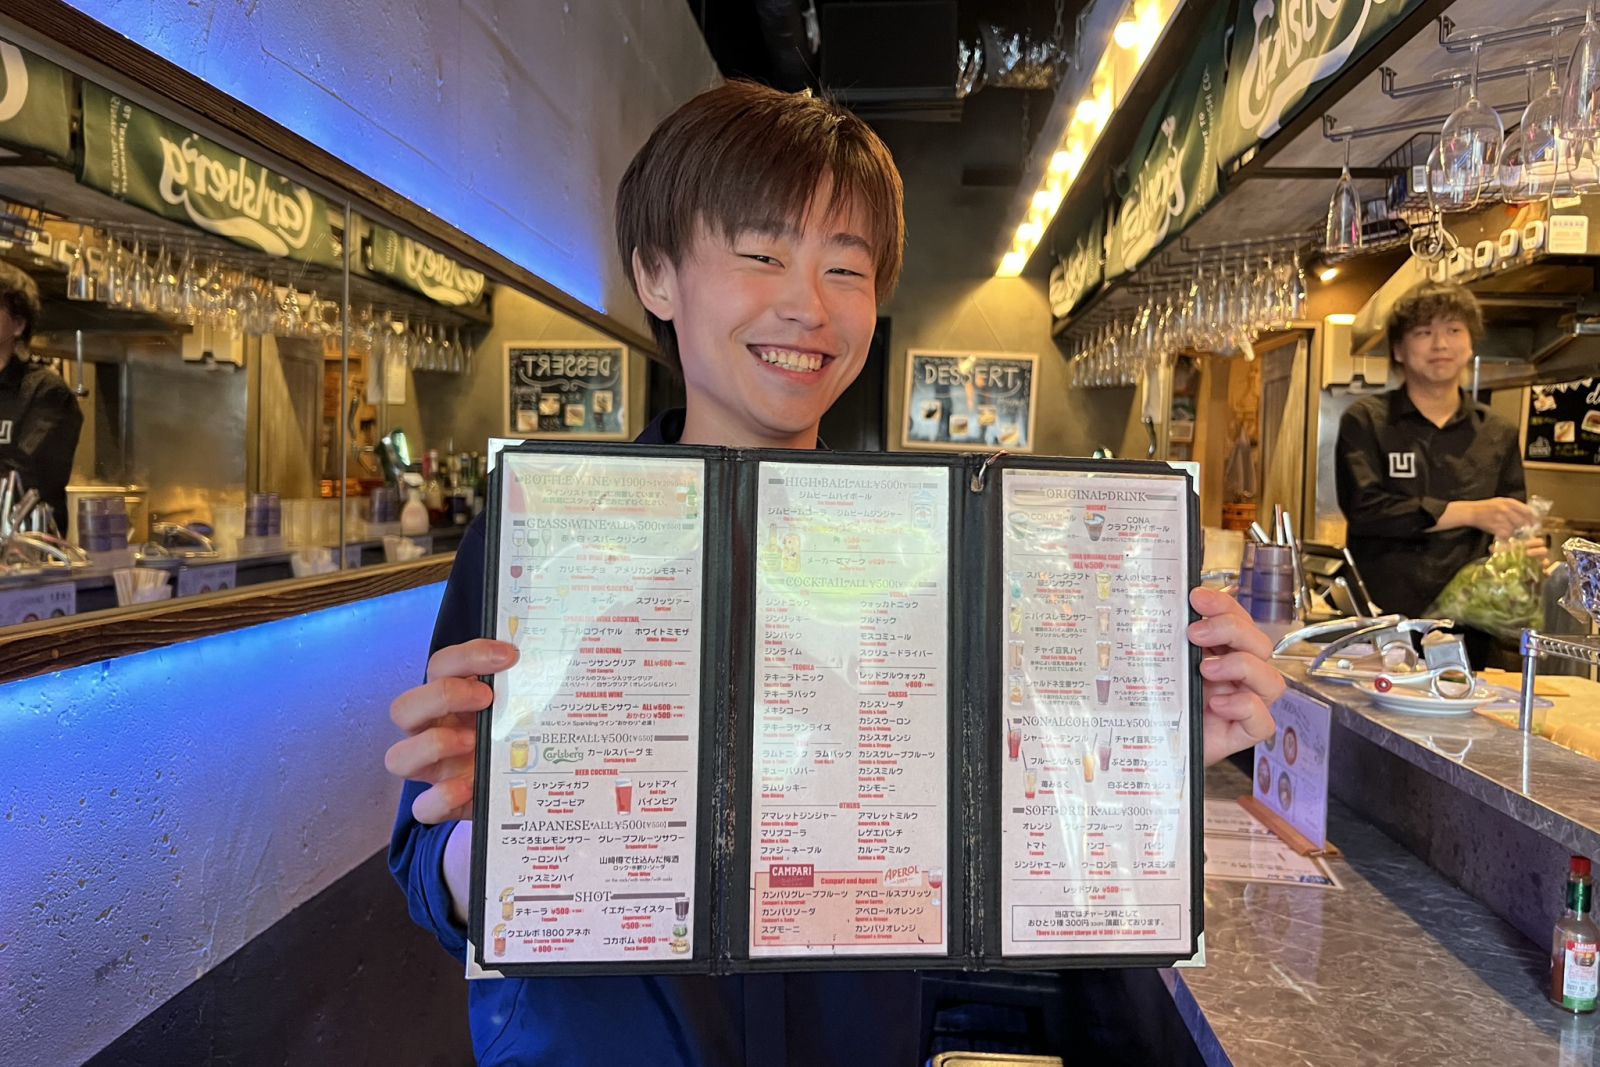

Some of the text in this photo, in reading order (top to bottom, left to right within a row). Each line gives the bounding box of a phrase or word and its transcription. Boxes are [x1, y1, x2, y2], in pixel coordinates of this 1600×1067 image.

[924, 364, 1020, 389] DESSERT
[524, 474, 573, 486] BOTTLE
[785, 477, 818, 488] HIGH
[821, 478, 852, 489] BALL
[799, 491, 873, 500] ジムビームハイボール
[1046, 488, 1146, 501] ORIGINAL DRINK
[836, 509, 903, 518] ジムビームジンジャー
[526, 518, 568, 529] GLASS
[570, 519, 607, 530] WINE
[1126, 516, 1151, 524] CONA
[1107, 523, 1170, 532] クラフトハイボール
[614, 566, 692, 575] アメリカンレモネード
[1026, 571, 1091, 580] スパイシークラフト
[785, 576, 846, 588] COCKTAIL
[860, 601, 919, 609] ウォッカトニック
[1025, 612, 1093, 621] スパイスレモンサワー
[559, 627, 623, 636] キールロワイヤル
[634, 628, 690, 636] ホワイトミモザ
[764, 631, 802, 639] ジンバック
[859, 632, 912, 641] モスコミュール
[764, 647, 803, 656] ジンライム
[859, 649, 933, 657] スクリュードライバー
[1034, 646, 1084, 655] チャイ豆乳ハイ
[763, 673, 824, 681] テキーラトニック
[859, 672, 926, 680] レッドブルウォッカ
[1112, 676, 1176, 684] カベルネベリーサワー
[763, 690, 817, 698] テキーラバック
[763, 707, 809, 715] メキシコーク
[858, 717, 911, 725] カシスウーロン
[1022, 716, 1048, 726] NON
[1051, 716, 1106, 727] ALCOHOL
[763, 723, 832, 732] テキーラサンライズ
[541, 732, 577, 744] BEER
[579, 734, 600, 743] ALL
[858, 734, 912, 742] カシスオレンジ
[1023, 733, 1089, 742] シャーリーテンプル
[1114, 735, 1165, 744] チャイ豆乳ラテ
[543, 746, 584, 764] Carlsberg
[587, 748, 653, 757] カールスバーグ 生
[814, 750, 852, 758] ラムバック
[858, 751, 936, 759] カシスグレープフルーツ
[762, 767, 815, 775] キューバリバー
[858, 767, 904, 776] カシスミルク
[532, 781, 590, 789] シャンディガフ
[638, 780, 677, 788] レッドアイ
[762, 784, 808, 792] ラムリッキー
[858, 784, 896, 792] カシモーニ
[536, 799, 585, 807] マンゴービア
[1025, 805, 1056, 816] SOFT
[761, 812, 838, 820] アマレットジンジャー
[858, 812, 918, 820] アマレットミルク
[521, 820, 591, 832] JAPANESE
[593, 822, 613, 830] ALL
[761, 829, 807, 837] マリブコーラ
[501, 836, 590, 844] ごろごろ生レモンサワー
[598, 834, 685, 843] グレープフルーツサワー
[760, 846, 822, 855] ファジーネーブル
[858, 846, 911, 854] カルーアミルク
[521, 855, 570, 863] ウーロンハイ
[1014, 861, 1066, 869] ジンジャエール
[1081, 861, 1118, 869] ウーロン茶
[1133, 861, 1176, 869] ジャスミン茶
[772, 866, 812, 877] CAMPARI
[884, 865, 920, 881] APEROL
[518, 874, 574, 882] ジャスミンハイ
[820, 877, 846, 885] Campari
[1063, 886, 1100, 894] レッドブル
[574, 890, 612, 903] SHOT
[515, 907, 548, 916] テキーラ
[601, 905, 673, 914] イエガーマイスター
[1054, 910, 1139, 918] 当店ではチャージ料として
[542, 929, 565, 937] 1800
[566, 928, 590, 936] アネホ
